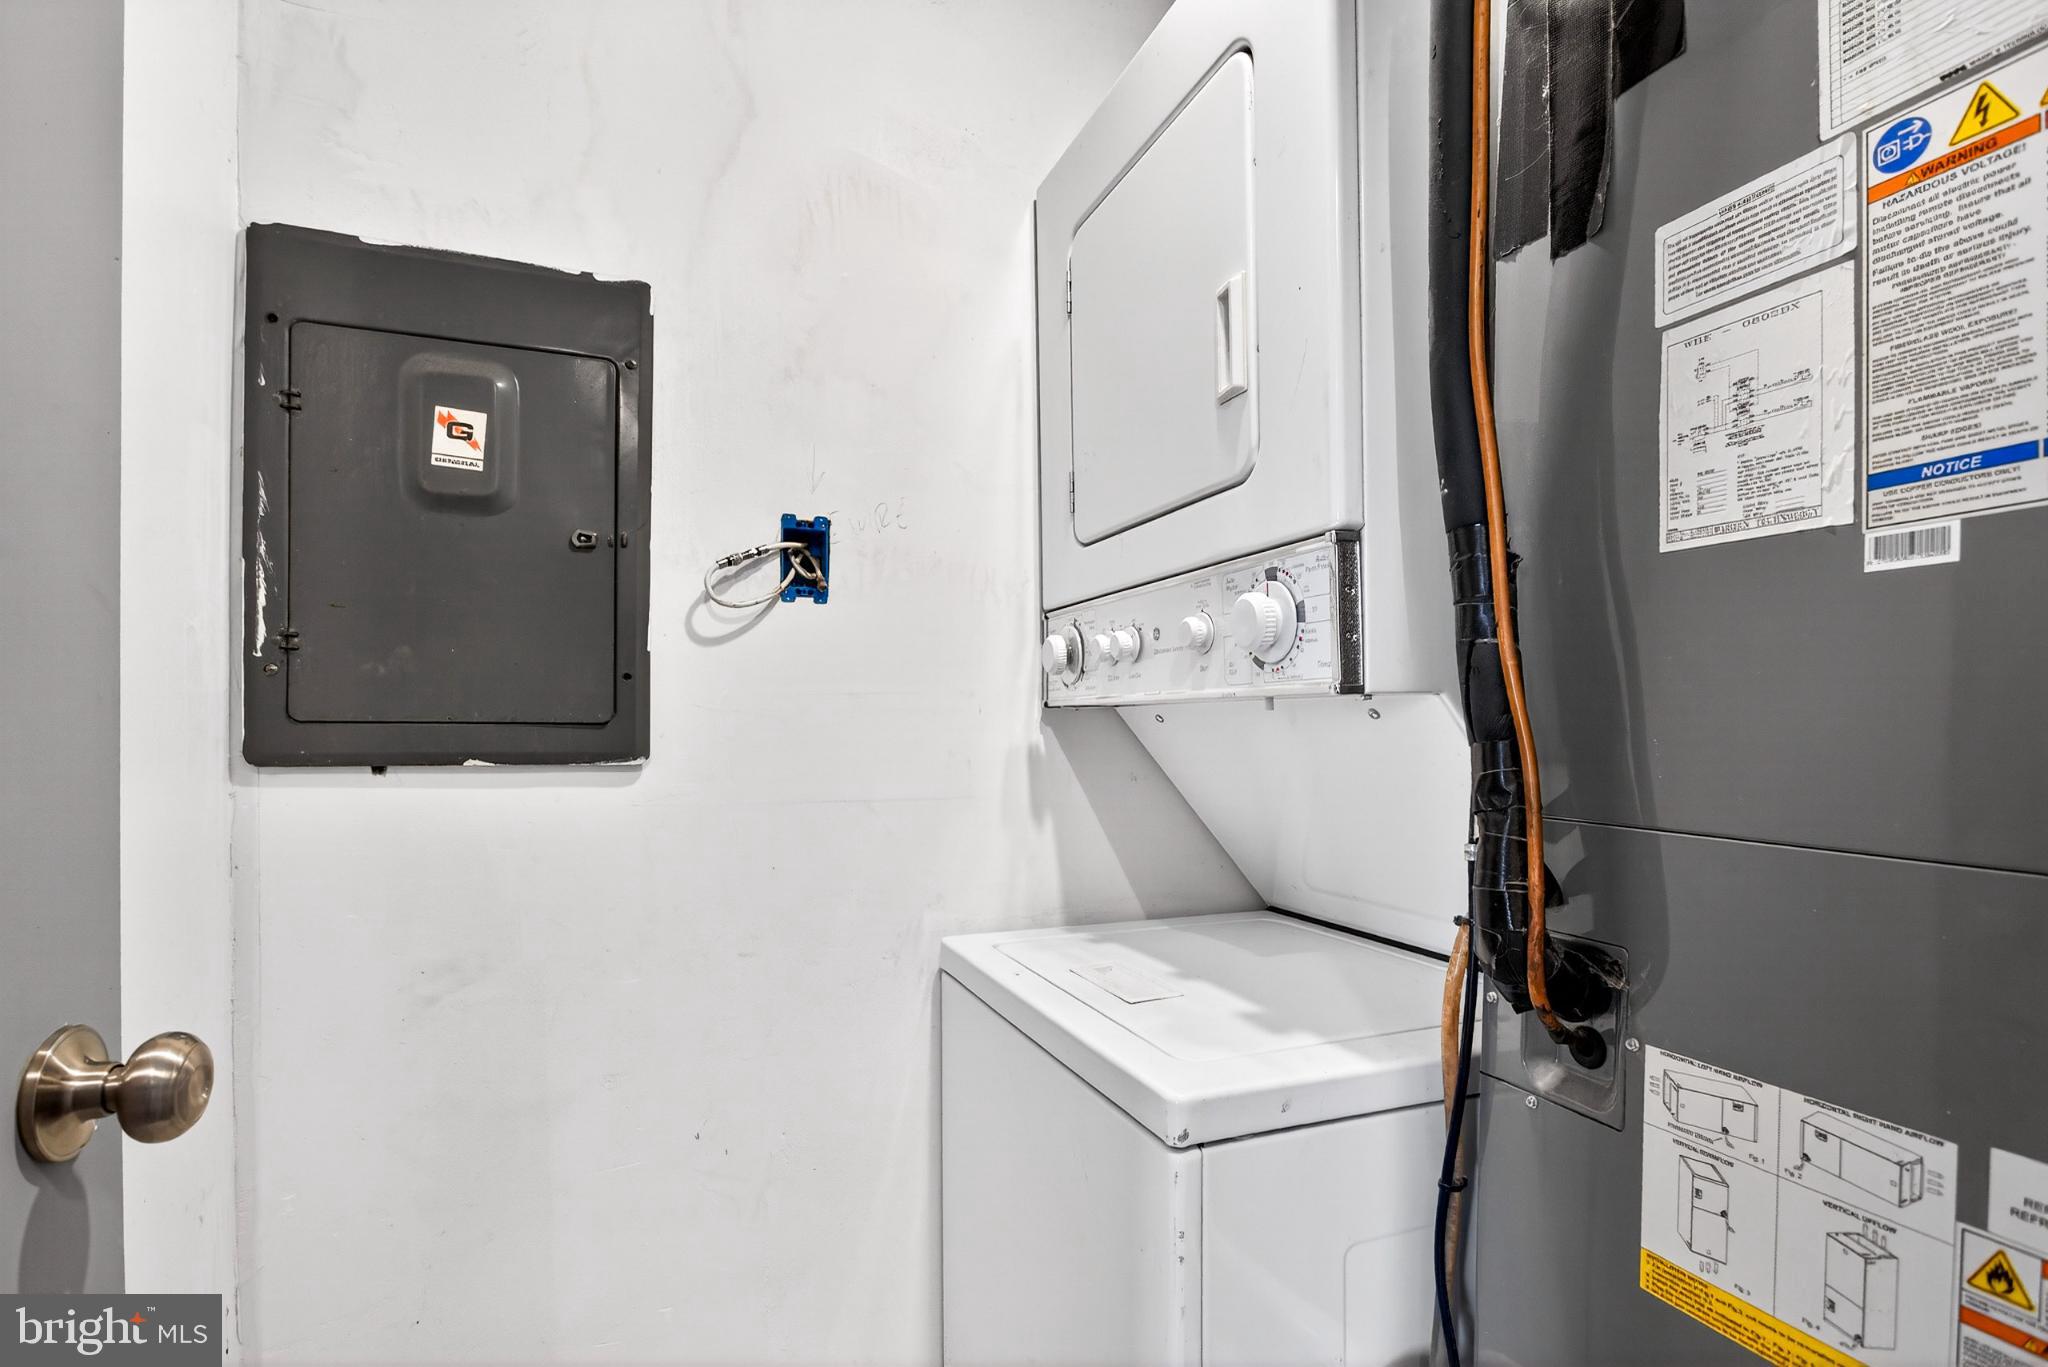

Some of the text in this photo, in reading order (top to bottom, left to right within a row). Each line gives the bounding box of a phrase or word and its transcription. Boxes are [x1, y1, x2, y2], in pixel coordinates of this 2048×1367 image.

[1920, 135, 1997, 178] WARNING
[1882, 141, 2026, 209] HAZARDOUS VOLTAGE!
[1921, 455, 1983, 478] NOTICE
[1822, 1198, 1860, 1220] VERTICAL
